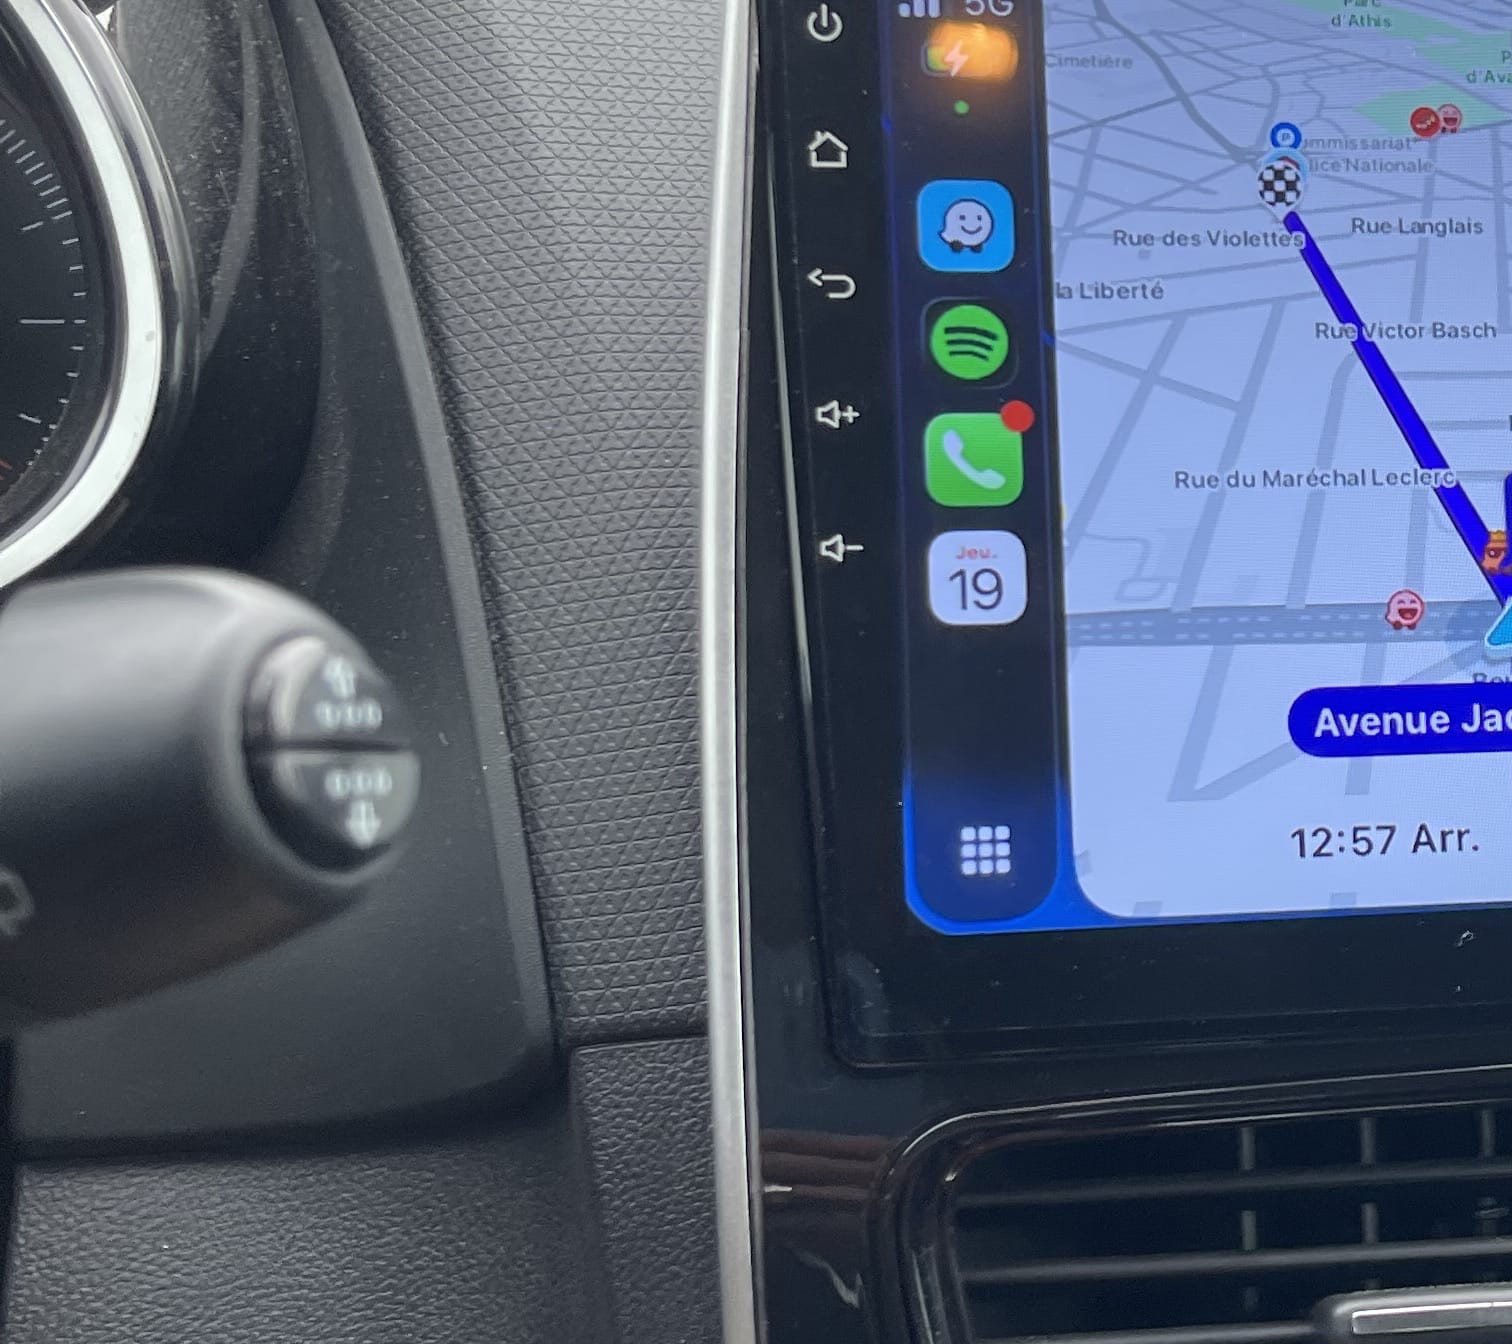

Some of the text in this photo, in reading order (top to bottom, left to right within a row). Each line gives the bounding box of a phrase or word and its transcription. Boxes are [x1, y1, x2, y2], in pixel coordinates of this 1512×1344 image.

[1303, 137, 1411, 151] mmissariat
[1345, 159, 1433, 173] Nationale
[1352, 217, 1483, 237] Rue Langlais
[1114, 229, 1304, 247] Rue des Violettes
[1056, 281, 1164, 299] la Liberté
[1315, 321, 1497, 339] Rue Victor Basch
[1175, 468, 1455, 489] Rue du Maréchal Leclerc
[955, 546, 997, 560] Jeu.
[949, 568, 1003, 610] 19
[1314, 707, 1450, 737] Avenue
[1291, 824, 1397, 858] 12:57
[1412, 823, 1479, 853] Arr.
